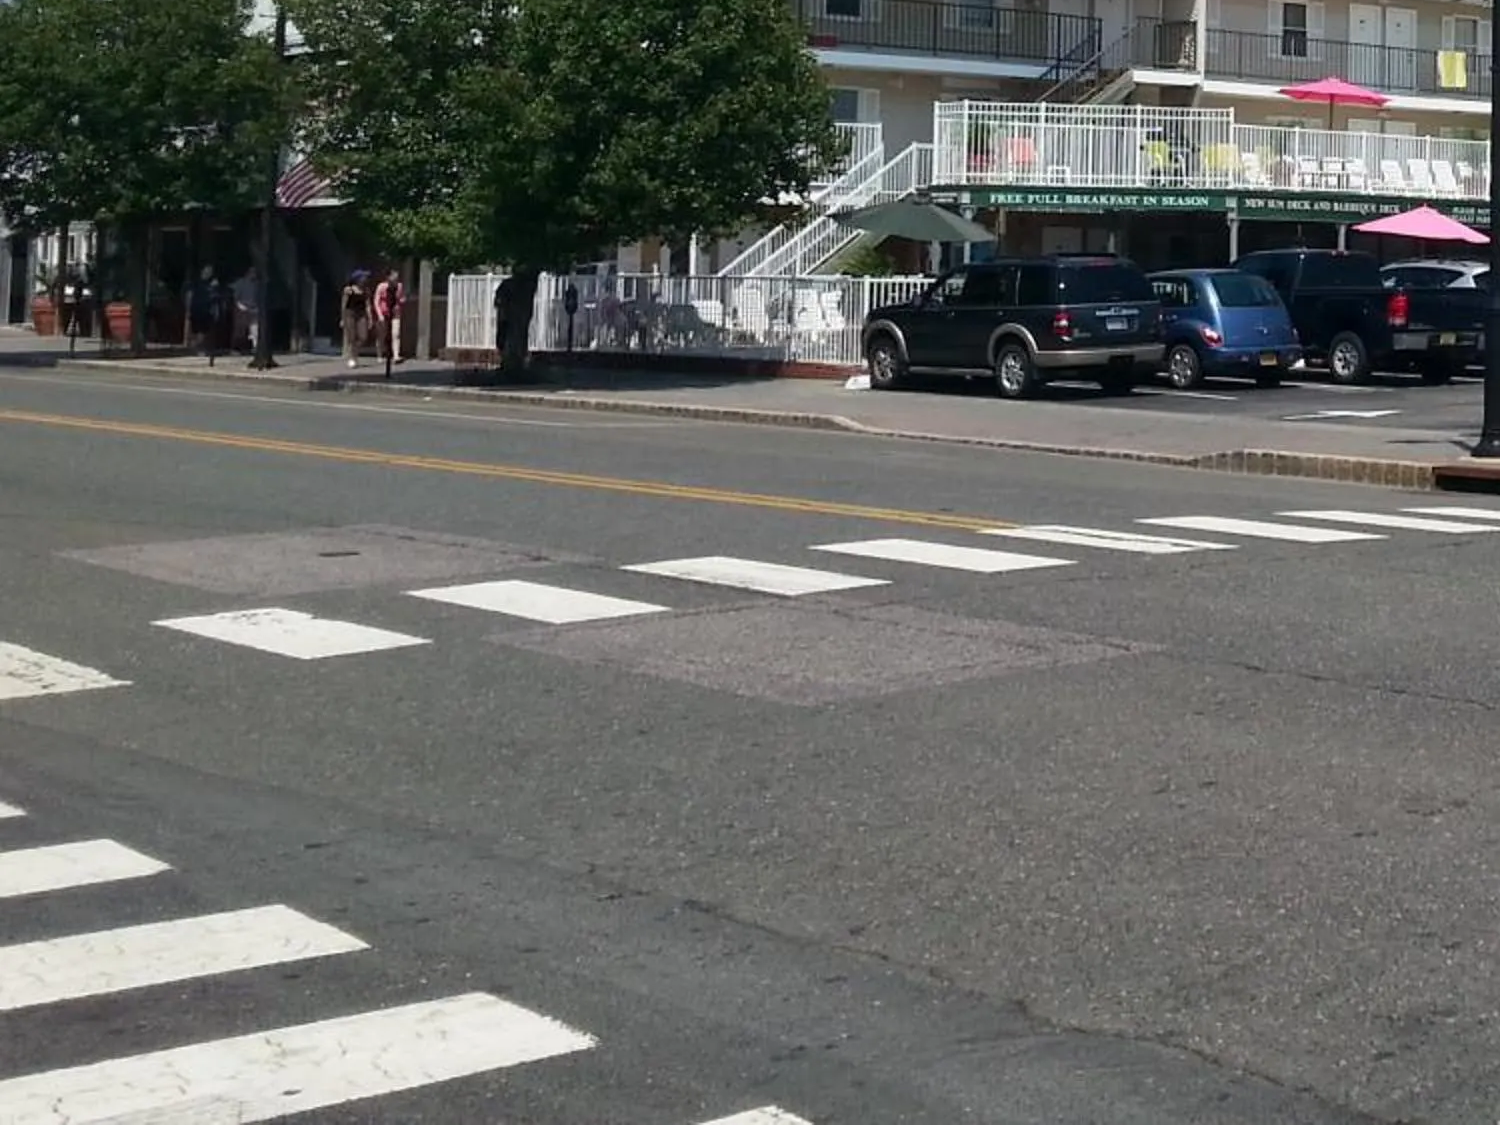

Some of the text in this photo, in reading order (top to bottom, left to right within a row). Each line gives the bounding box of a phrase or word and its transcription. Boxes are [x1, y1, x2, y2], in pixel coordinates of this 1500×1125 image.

[990, 193, 1209, 207] FREE FULL BREAKFAST IN SEASON
[1245, 197, 1266, 208] NEW
[1267, 198, 1285, 210] SUN
[1286, 199, 1311, 211] DECK
[1313, 201, 1331, 212] AND
